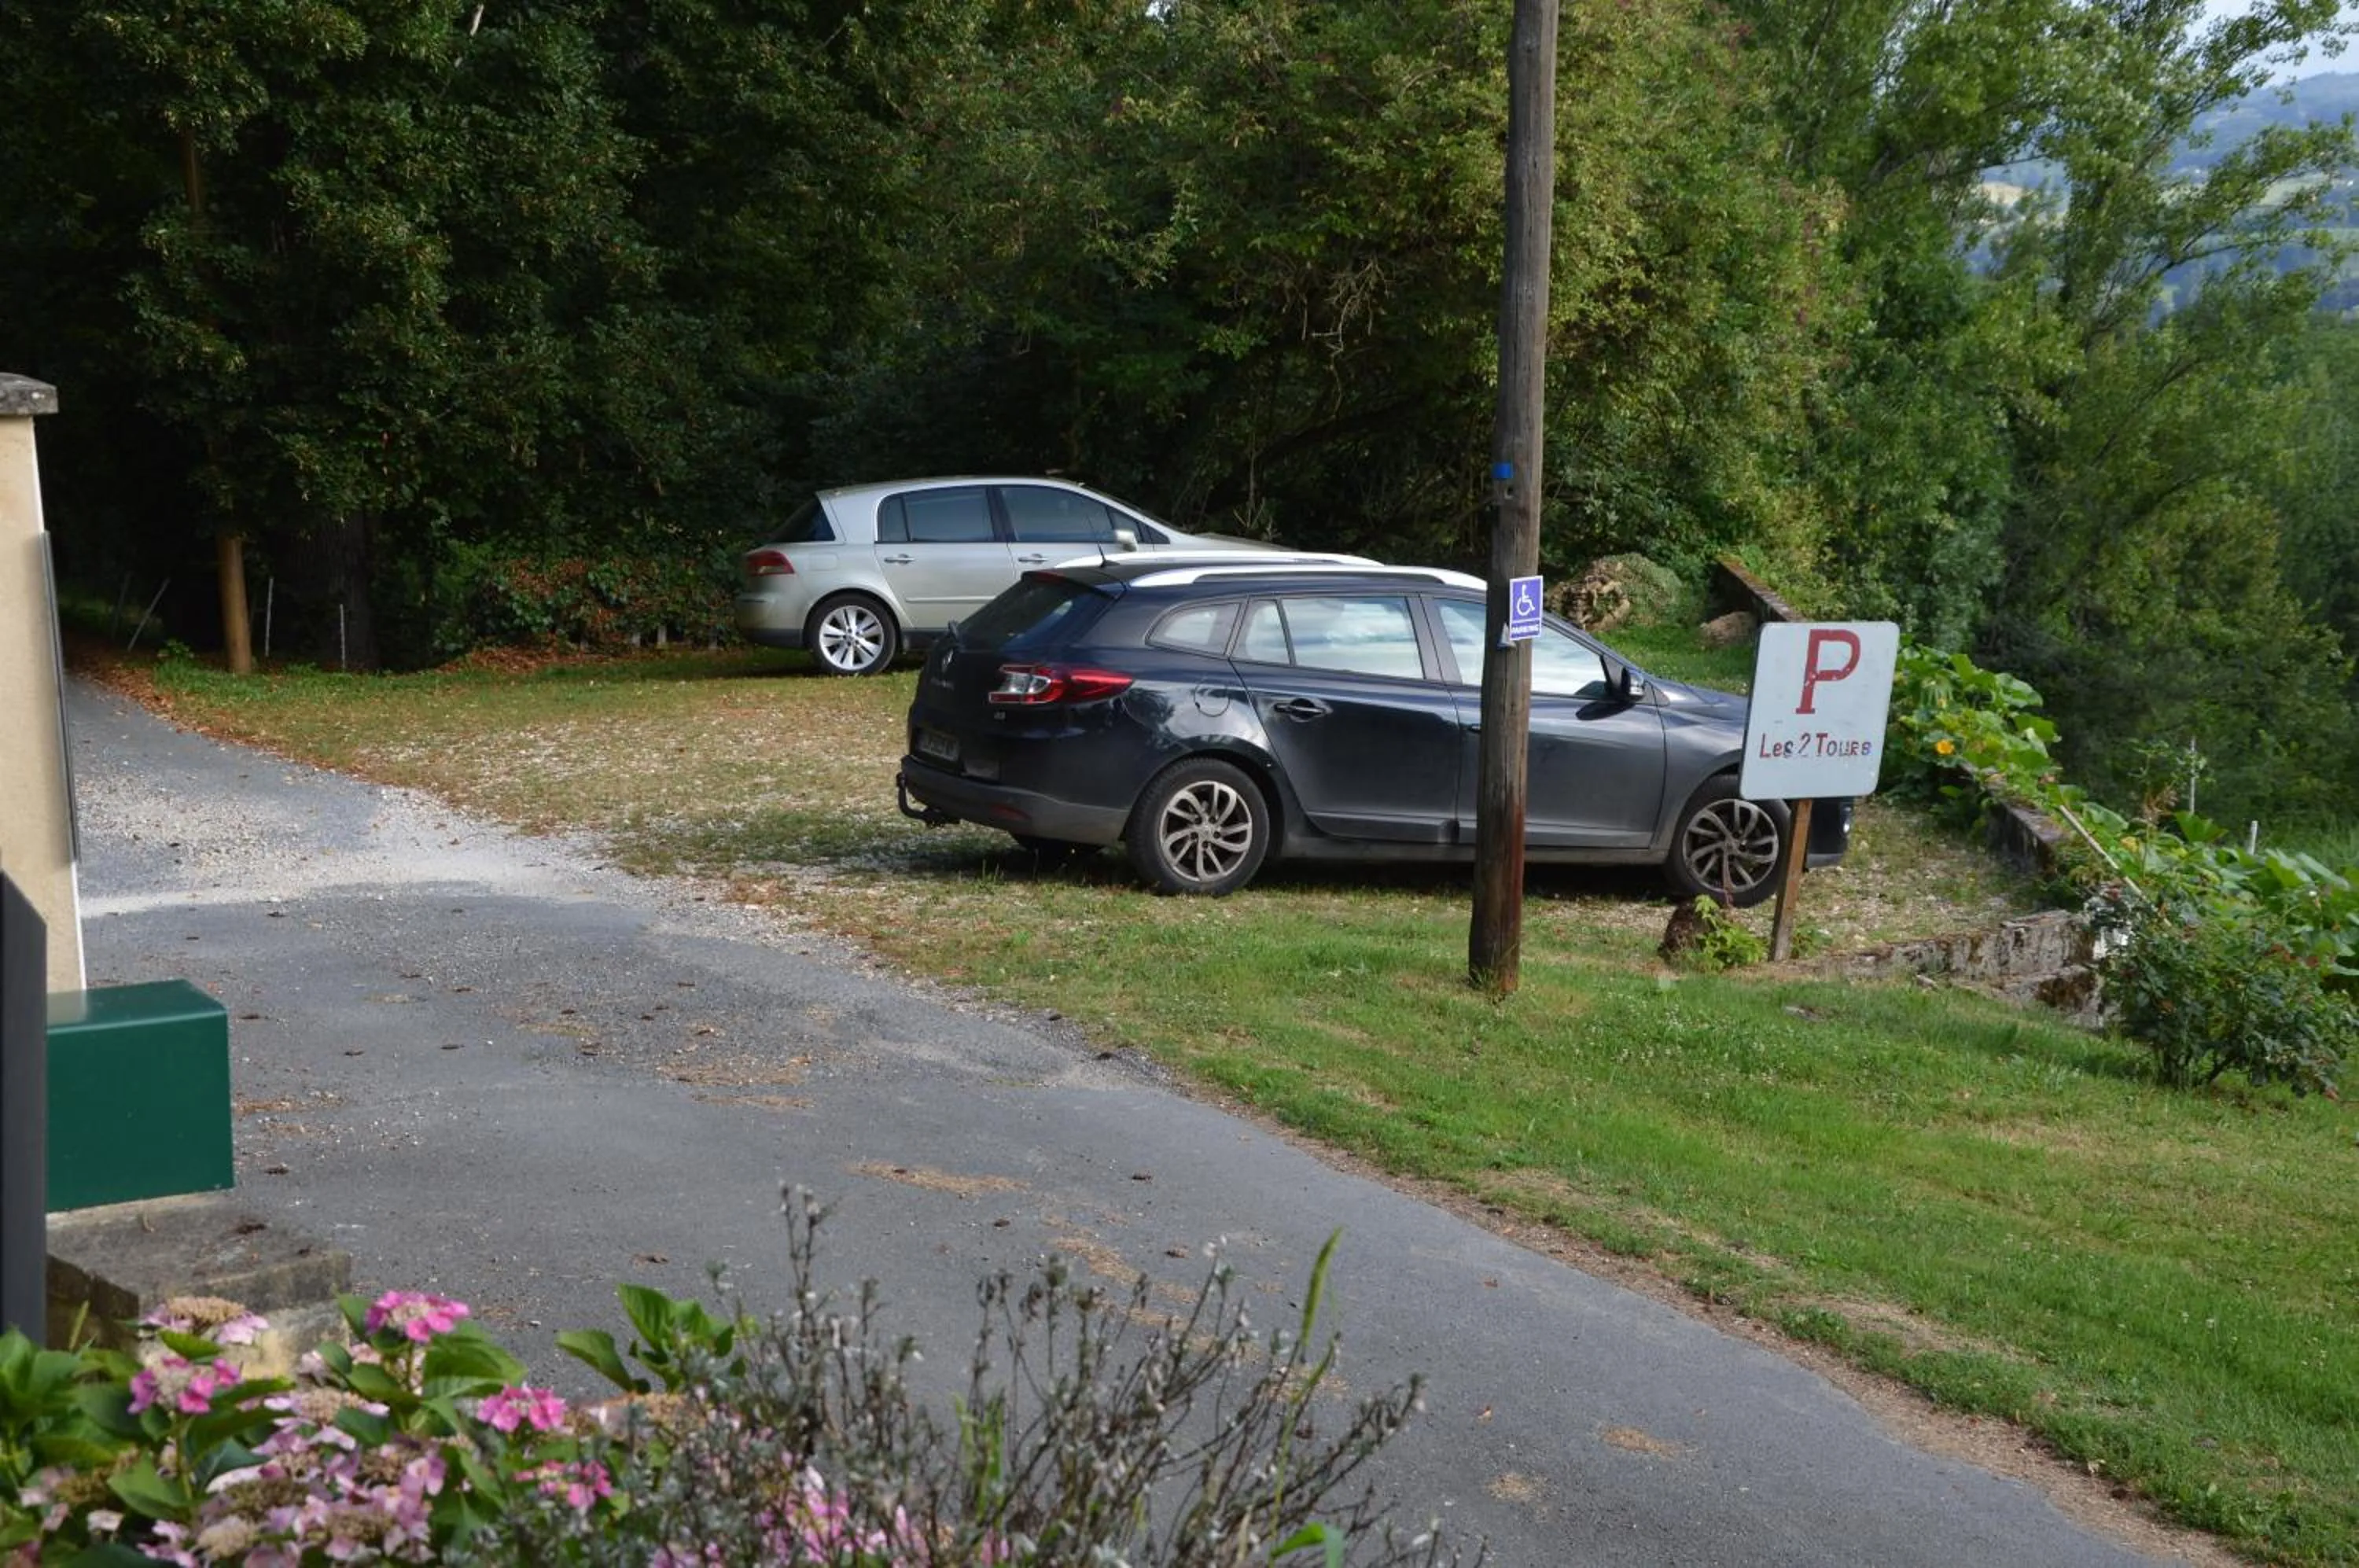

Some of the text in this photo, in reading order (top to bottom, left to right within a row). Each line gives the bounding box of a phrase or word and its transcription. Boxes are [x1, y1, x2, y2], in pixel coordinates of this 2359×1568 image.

[1795, 628, 1861, 714] P
[1759, 732, 1794, 759] Les
[1797, 732, 1811, 758] 2
